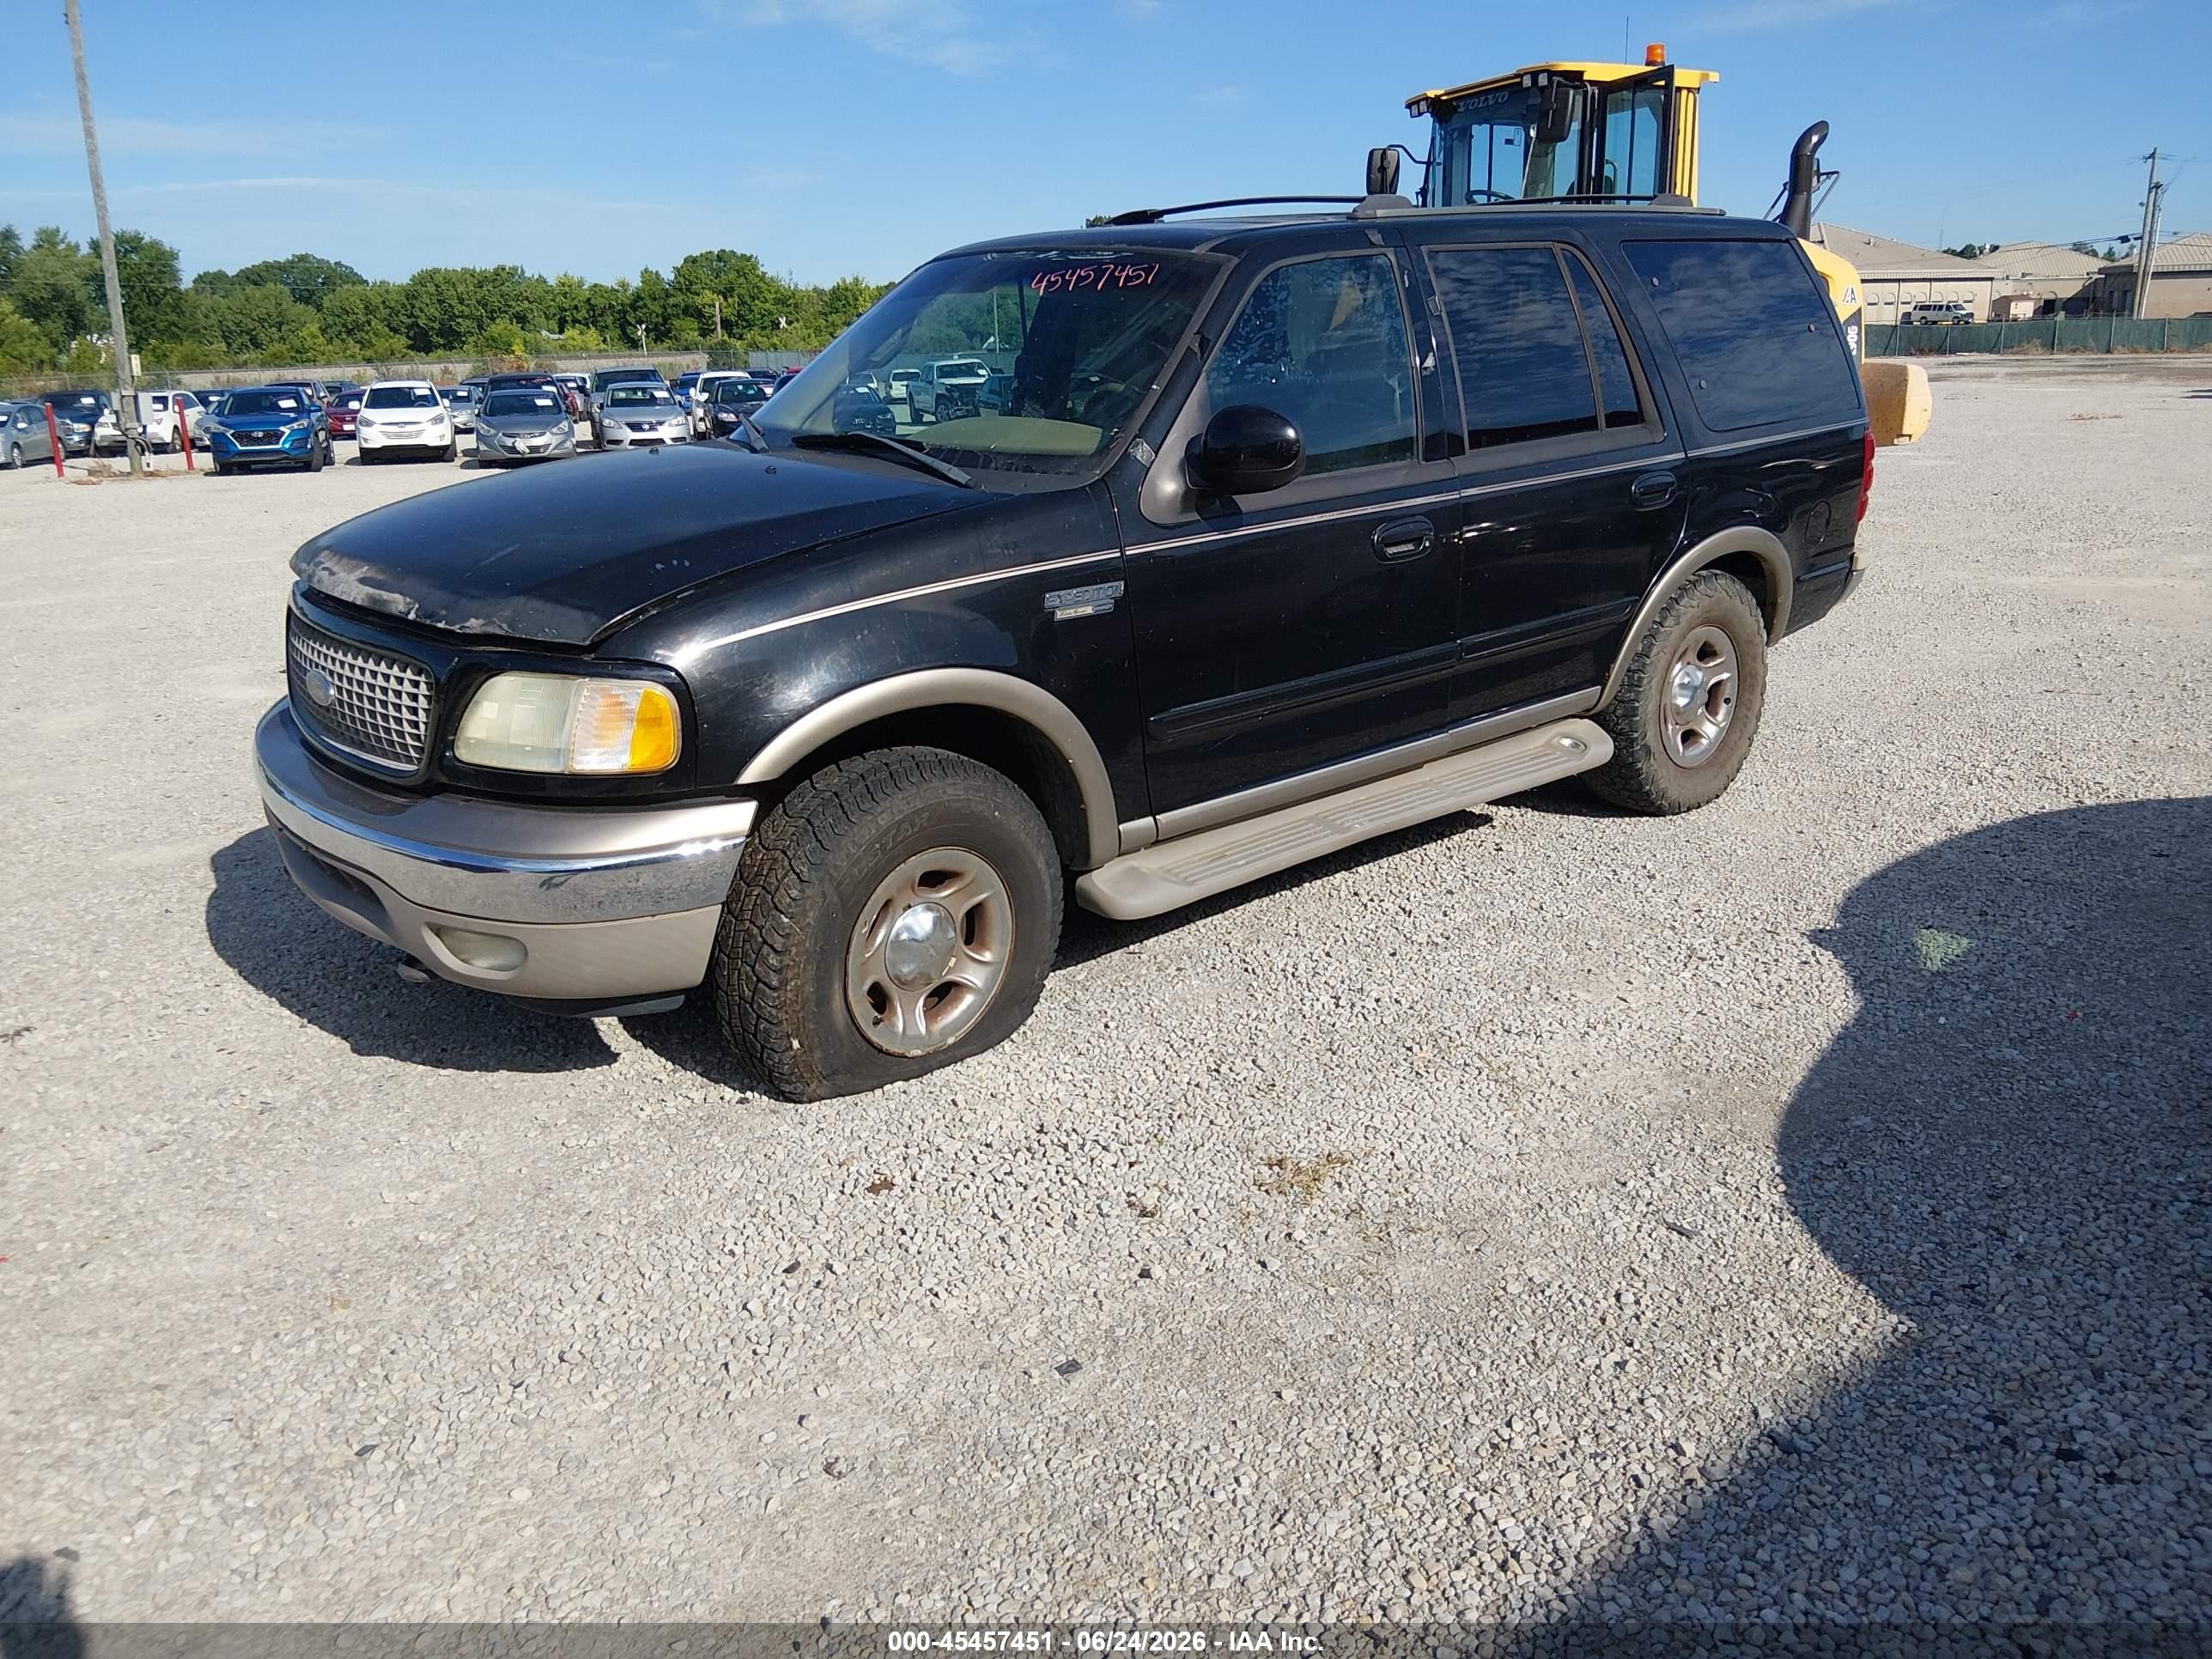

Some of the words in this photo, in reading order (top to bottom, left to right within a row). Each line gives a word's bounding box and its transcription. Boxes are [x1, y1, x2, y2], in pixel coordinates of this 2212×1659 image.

[1456, 91, 1509, 111] VOLVO
[1031, 263, 1159, 296] 45457451
[1047, 583, 1124, 608] EXPEDITION
